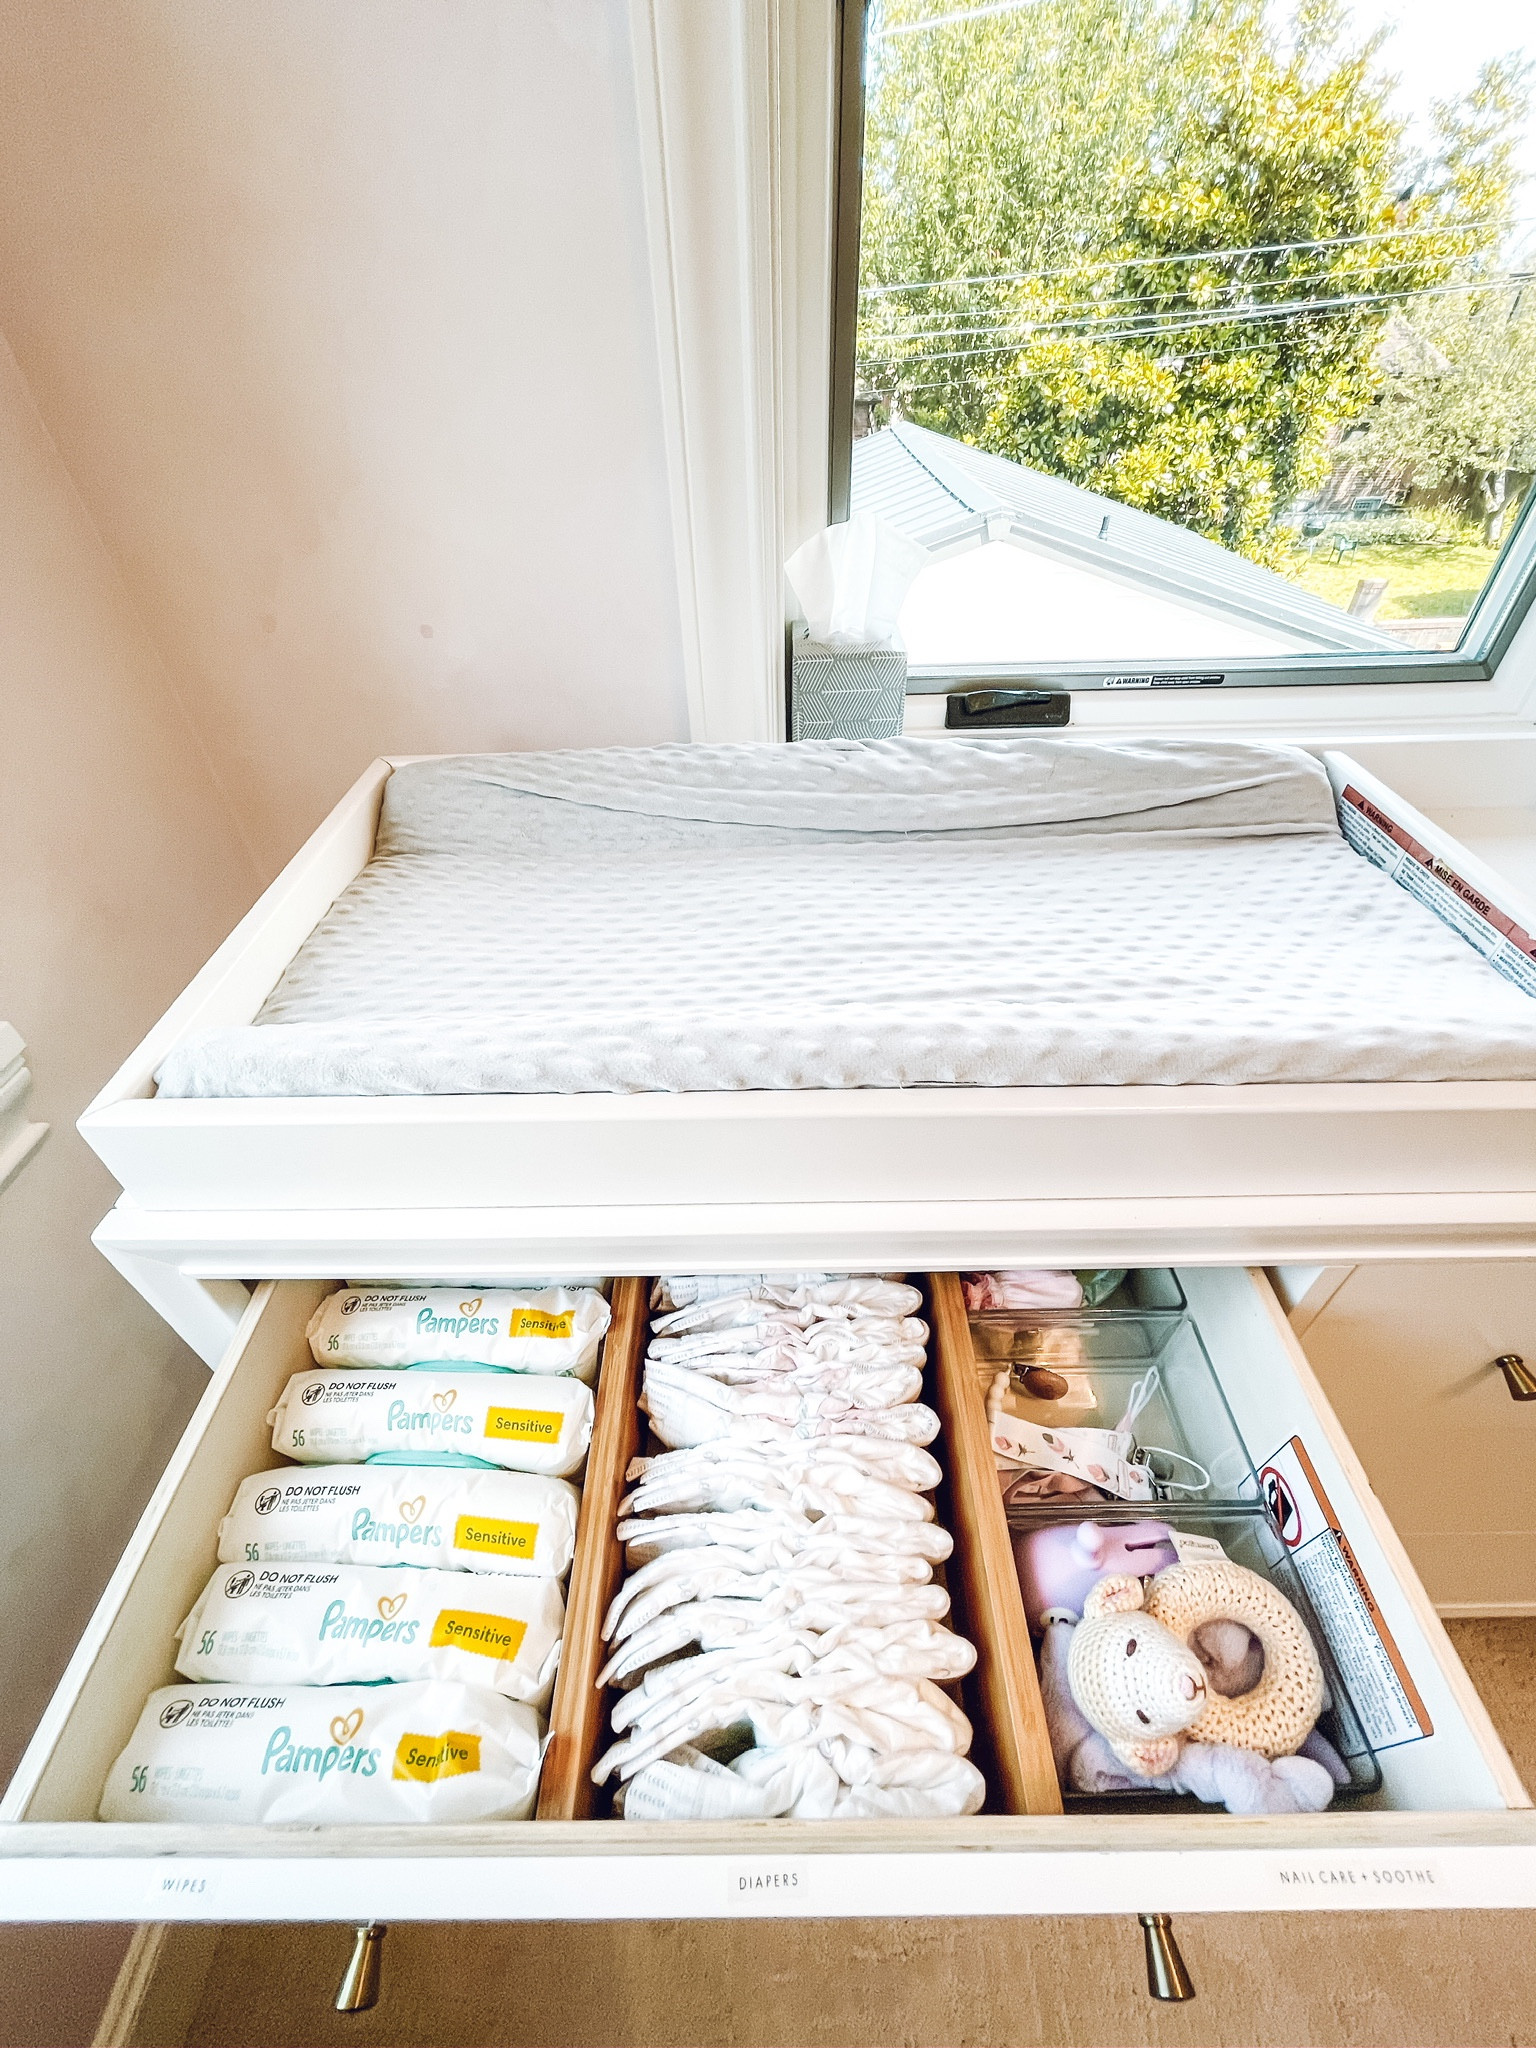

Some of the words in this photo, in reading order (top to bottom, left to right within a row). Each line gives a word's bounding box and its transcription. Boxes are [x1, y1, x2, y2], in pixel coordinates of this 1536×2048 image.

[1365, 806, 1394, 833] WARNING
[1435, 865, 1452, 884] MISE
[1452, 878, 1464, 892] EN
[1462, 889, 1492, 916] GARDE
[416, 1307, 500, 1339] Pampers
[327, 1334, 340, 1351] 56
[328, 1382, 345, 1390] DO
[366, 1382, 397, 1390] FLUSH
[387, 1400, 474, 1436] Pampers
[495, 1416, 553, 1434] Sensitive
[292, 1429, 305, 1447] 56
[285, 1486, 303, 1496] DO
[304, 1486, 328, 1496] NOT
[327, 1485, 361, 1495] FLUSH
[351, 1507, 442, 1548] Pampers
[465, 1527, 527, 1548] Sensitive
[245, 1543, 260, 1561] 56
[259, 1570, 279, 1582] DO
[279, 1573, 304, 1583] NOT
[303, 1573, 339, 1583] FLUSH
[1342, 1544, 1376, 1613] WARNING
[318, 1599, 420, 1648] Pampers
[444, 1620, 512, 1647] Sensitive
[197, 1630, 217, 1655] 56
[198, 1697, 219, 1707] DO
[219, 1697, 249, 1708] NOT
[247, 1697, 287, 1708] FLUSH
[260, 1725, 382, 1783] Pampers
[405, 1743, 469, 1768] Sentive
[129, 1765, 149, 1793] 56
[162, 1878, 207, 1893] WIPES
[739, 1873, 798, 1891] DIAPERS
[1279, 1871, 1315, 1884] NAIL
[1318, 1870, 1356, 1884] CARE
[1372, 1870, 1435, 1884] SOOTHE
